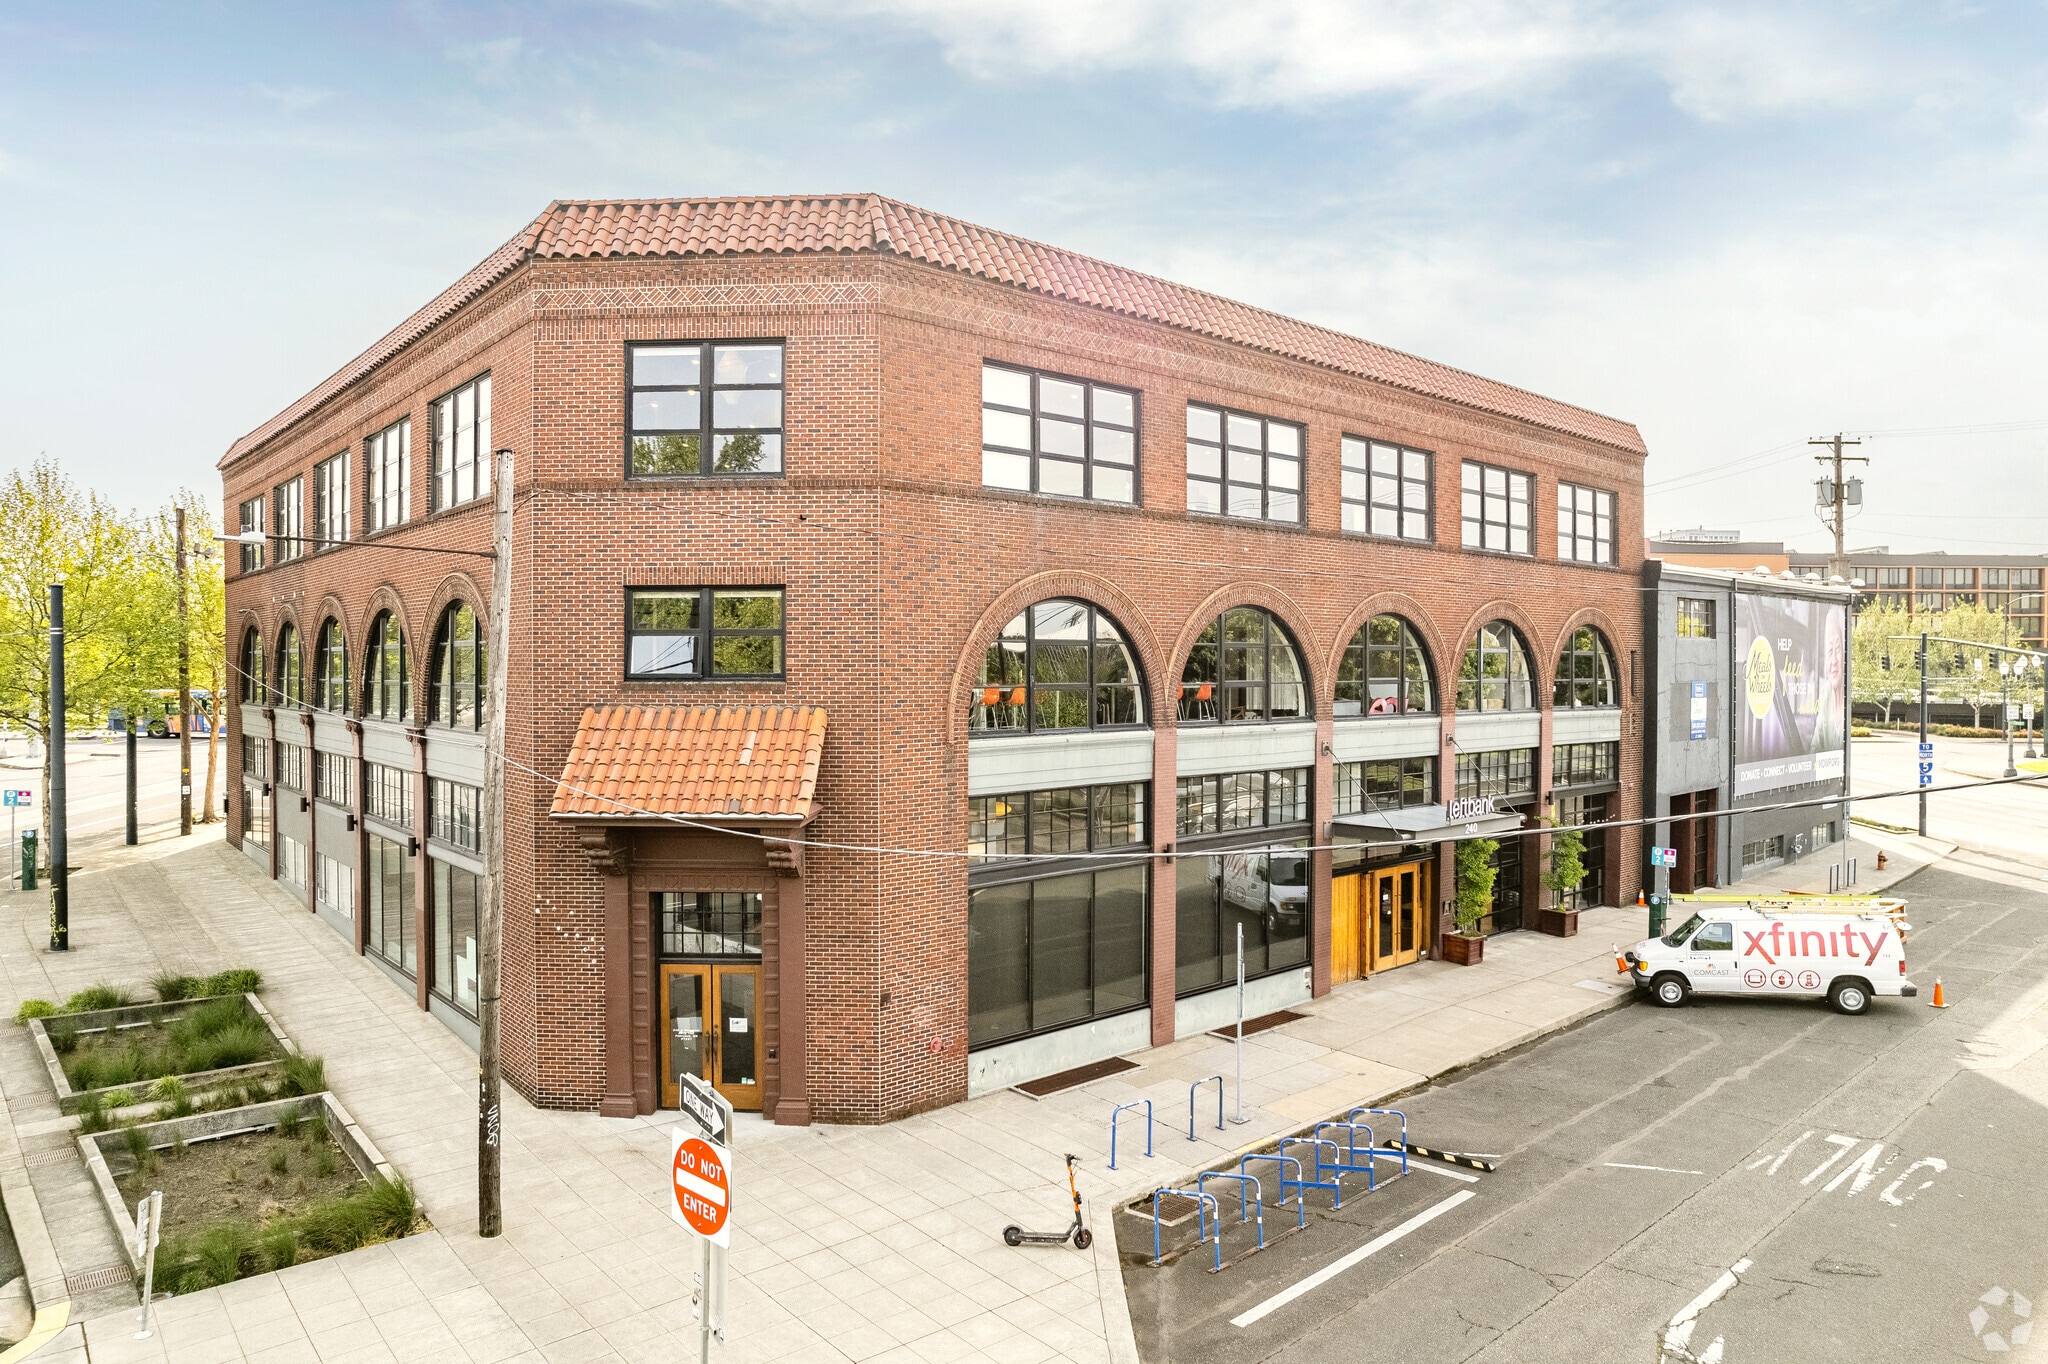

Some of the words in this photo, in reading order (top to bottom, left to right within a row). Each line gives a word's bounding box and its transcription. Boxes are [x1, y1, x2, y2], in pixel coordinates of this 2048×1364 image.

[1777, 637, 1792, 651] HELP
[1743, 650, 1771, 680] Meals
[1782, 654, 1804, 697] feed
[1749, 674, 1772, 693] Wheels
[1787, 682, 1807, 695] THOSE
[1740, 769, 1761, 782] DONATE
[1763, 765, 1786, 778] CONNECT
[1788, 761, 1812, 774] VOLUNTEER
[1923, 762, 1929, 772] 5
[1450, 794, 1495, 819] leftbank
[1465, 822, 1478, 835] 240
[1743, 921, 1888, 966] xfinity
[685, 1089, 698, 1112] ONE
[699, 1101, 714, 1125] WAY
[680, 1149, 695, 1169] DO
[700, 1158, 723, 1182] NOT
[683, 1192, 718, 1224] ENTER
